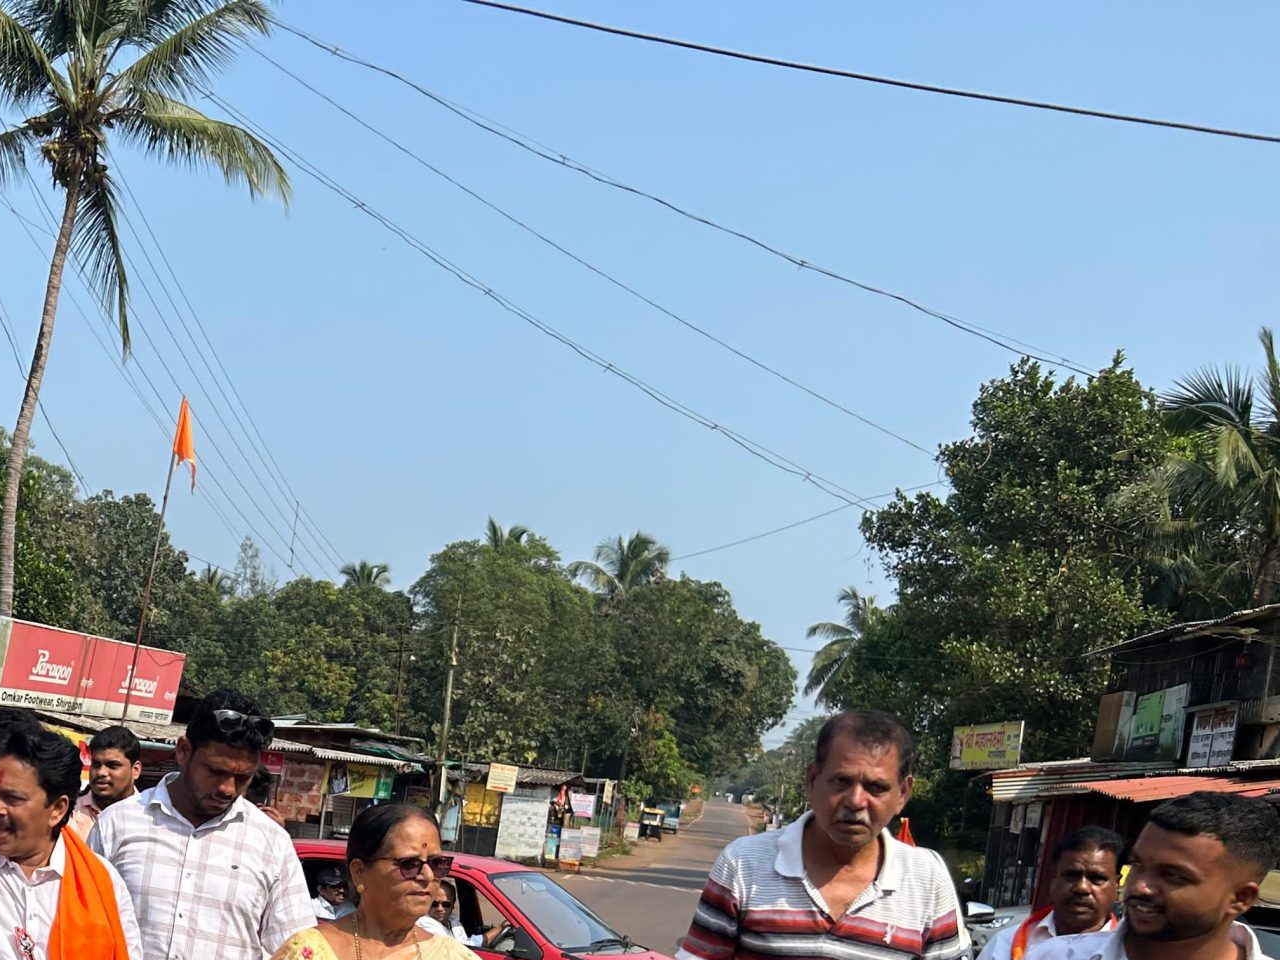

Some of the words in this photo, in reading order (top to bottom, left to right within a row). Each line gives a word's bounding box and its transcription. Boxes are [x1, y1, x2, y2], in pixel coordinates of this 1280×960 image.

[29, 649, 72, 684] Paragon
[1, 691, 24, 703] Omkar
[23, 694, 55, 708] Footwear,
